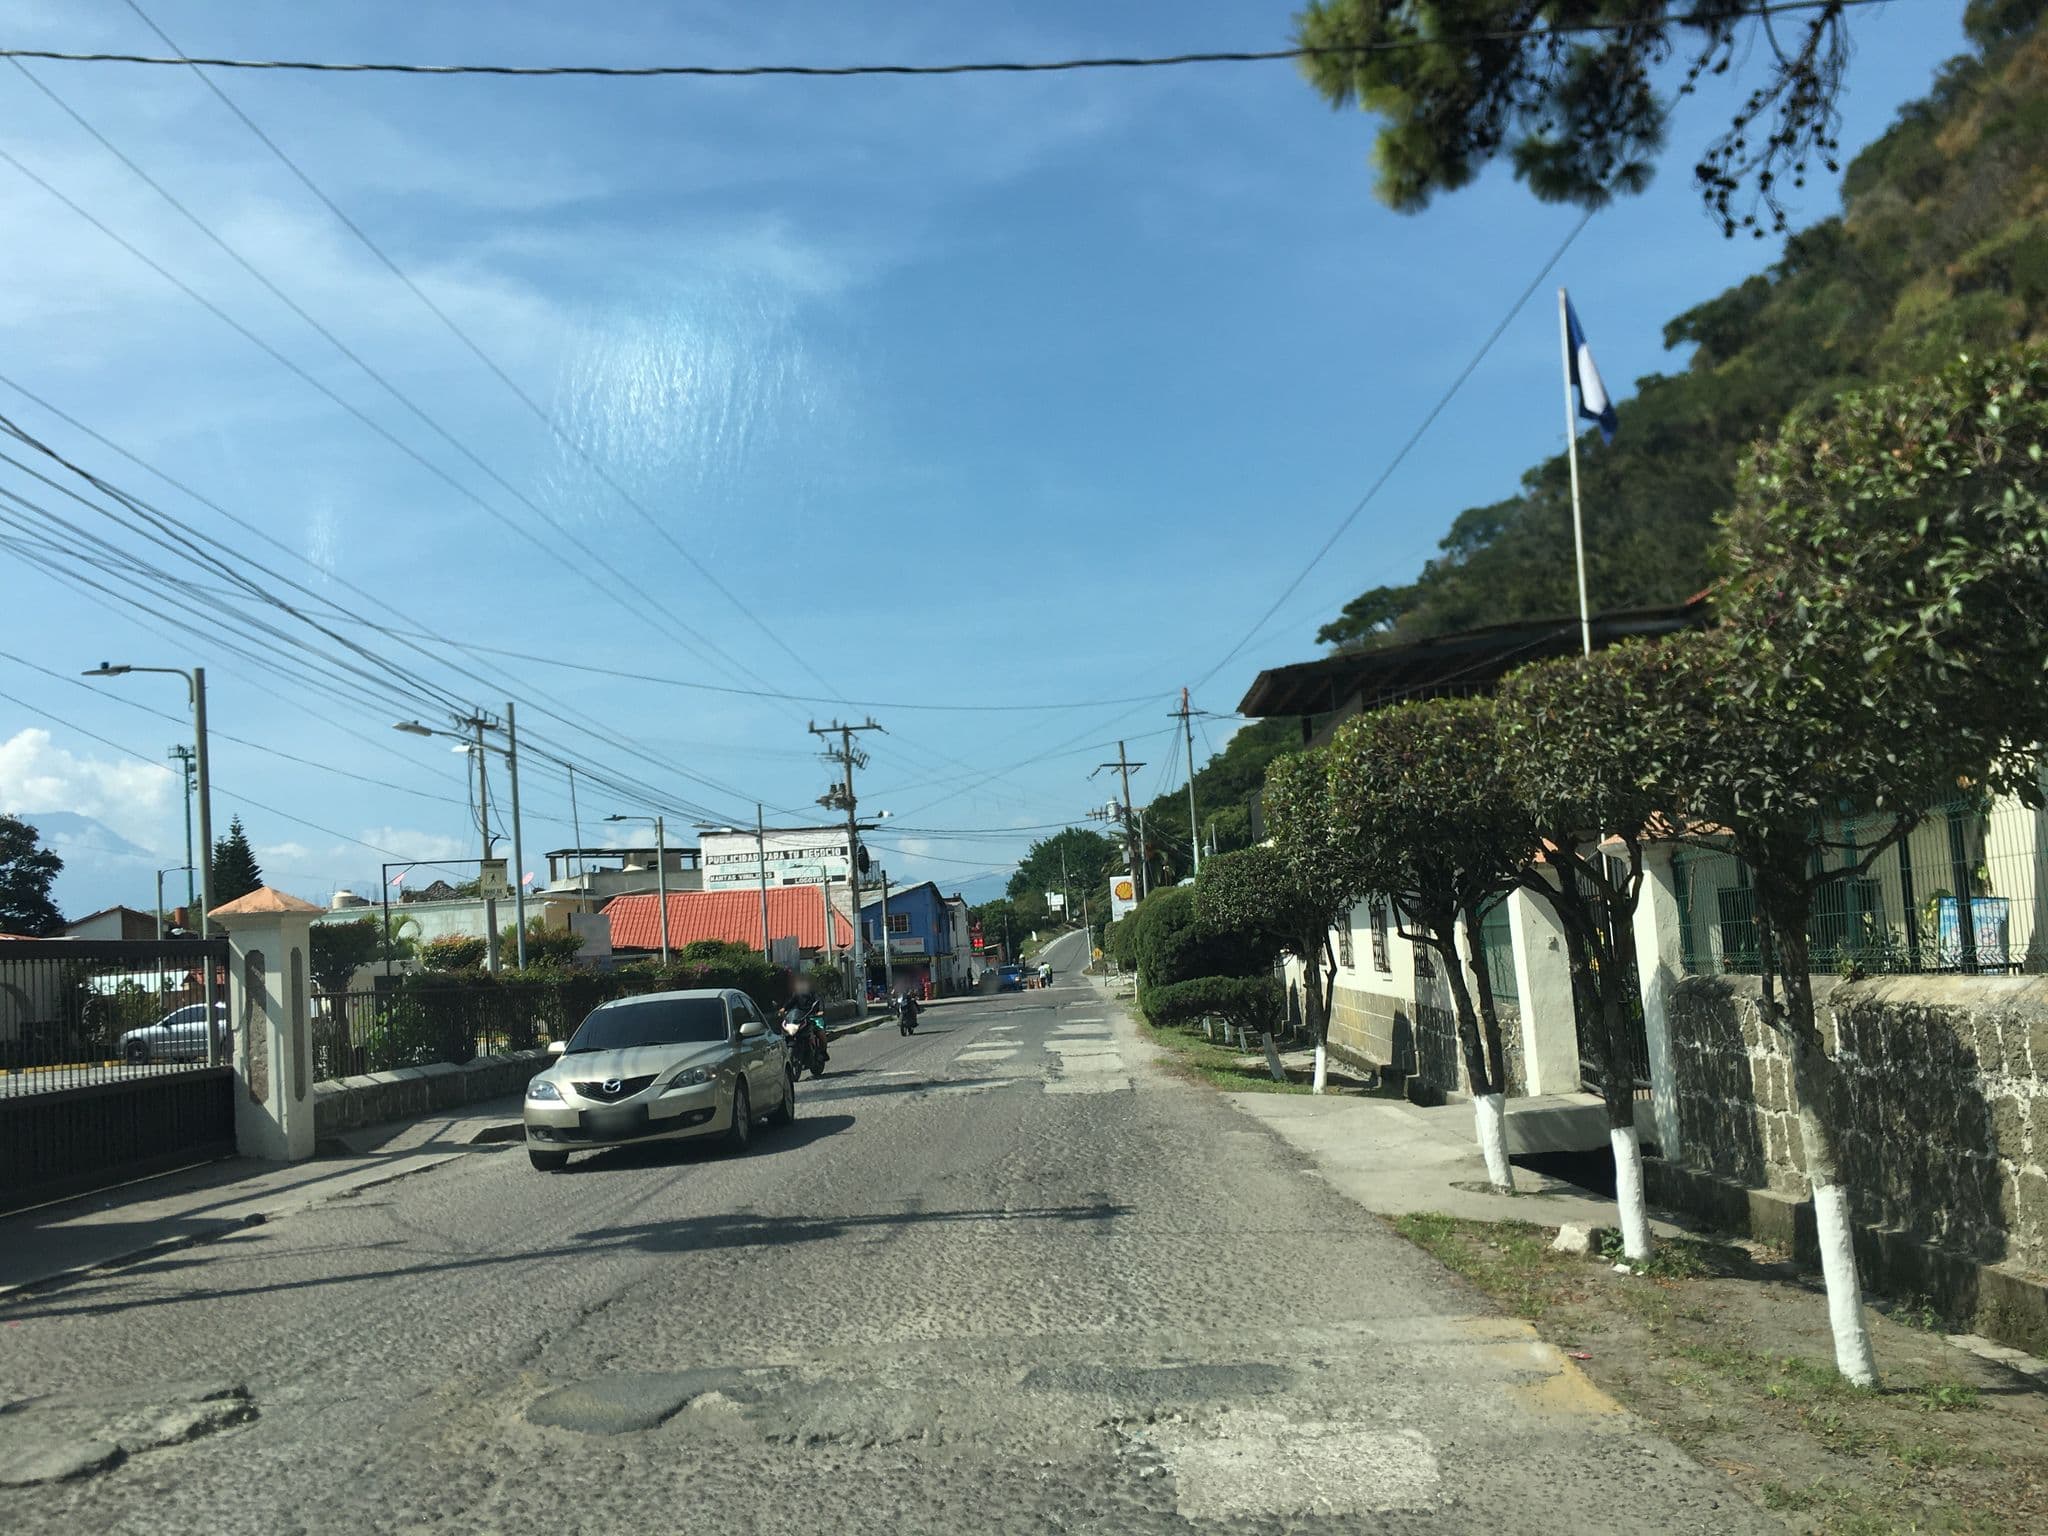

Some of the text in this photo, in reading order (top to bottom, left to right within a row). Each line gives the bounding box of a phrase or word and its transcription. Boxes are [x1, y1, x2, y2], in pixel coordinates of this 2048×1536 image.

[708, 847, 841, 865] PUBLICIDAD PARA TU NEGOCIO
